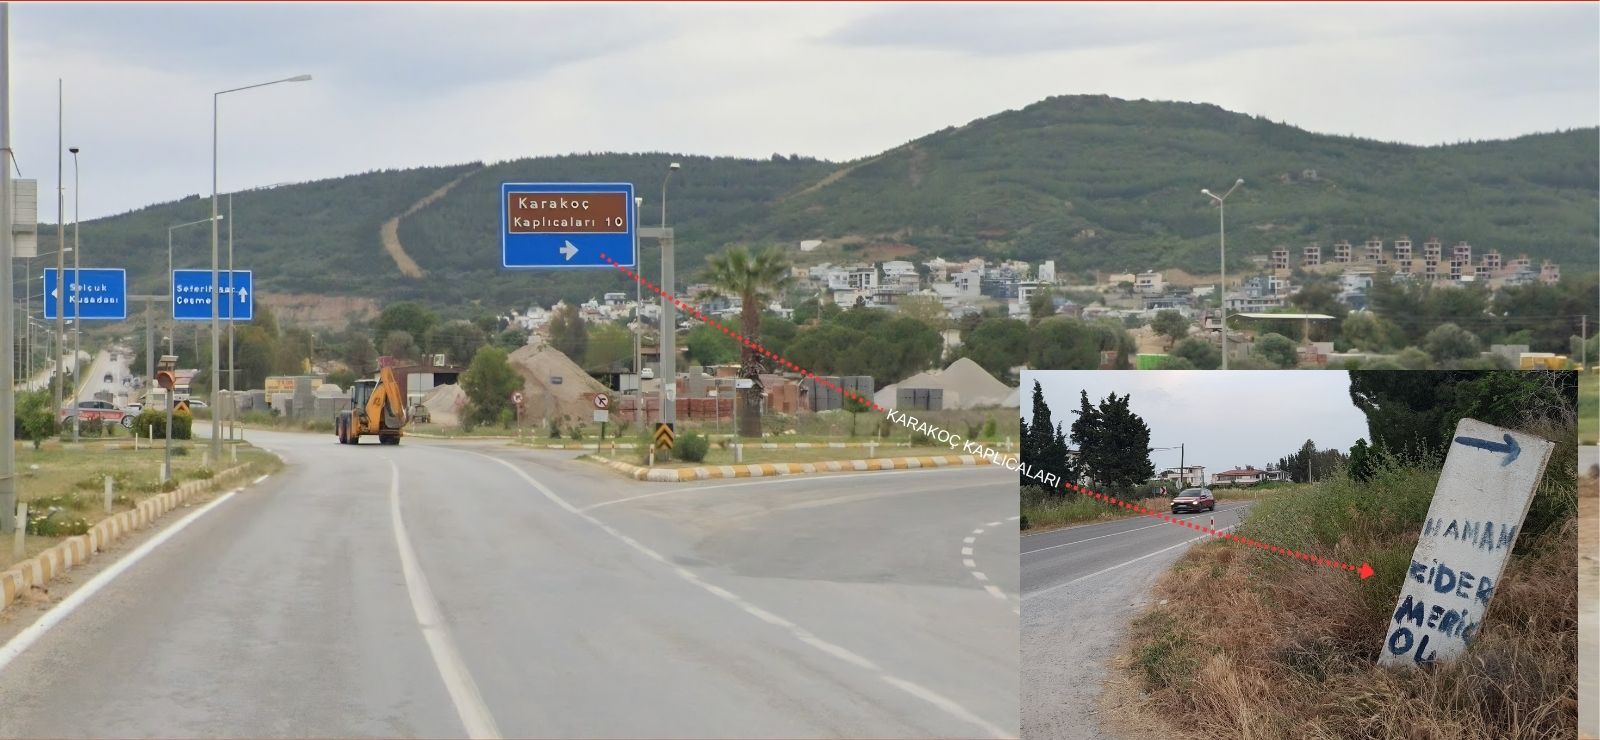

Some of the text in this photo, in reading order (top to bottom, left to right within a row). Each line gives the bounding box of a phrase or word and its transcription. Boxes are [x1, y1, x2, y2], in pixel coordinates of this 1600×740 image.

[518, 197, 590, 210] Karakoç
[513, 217, 624, 230] Kaplıcaları 10
